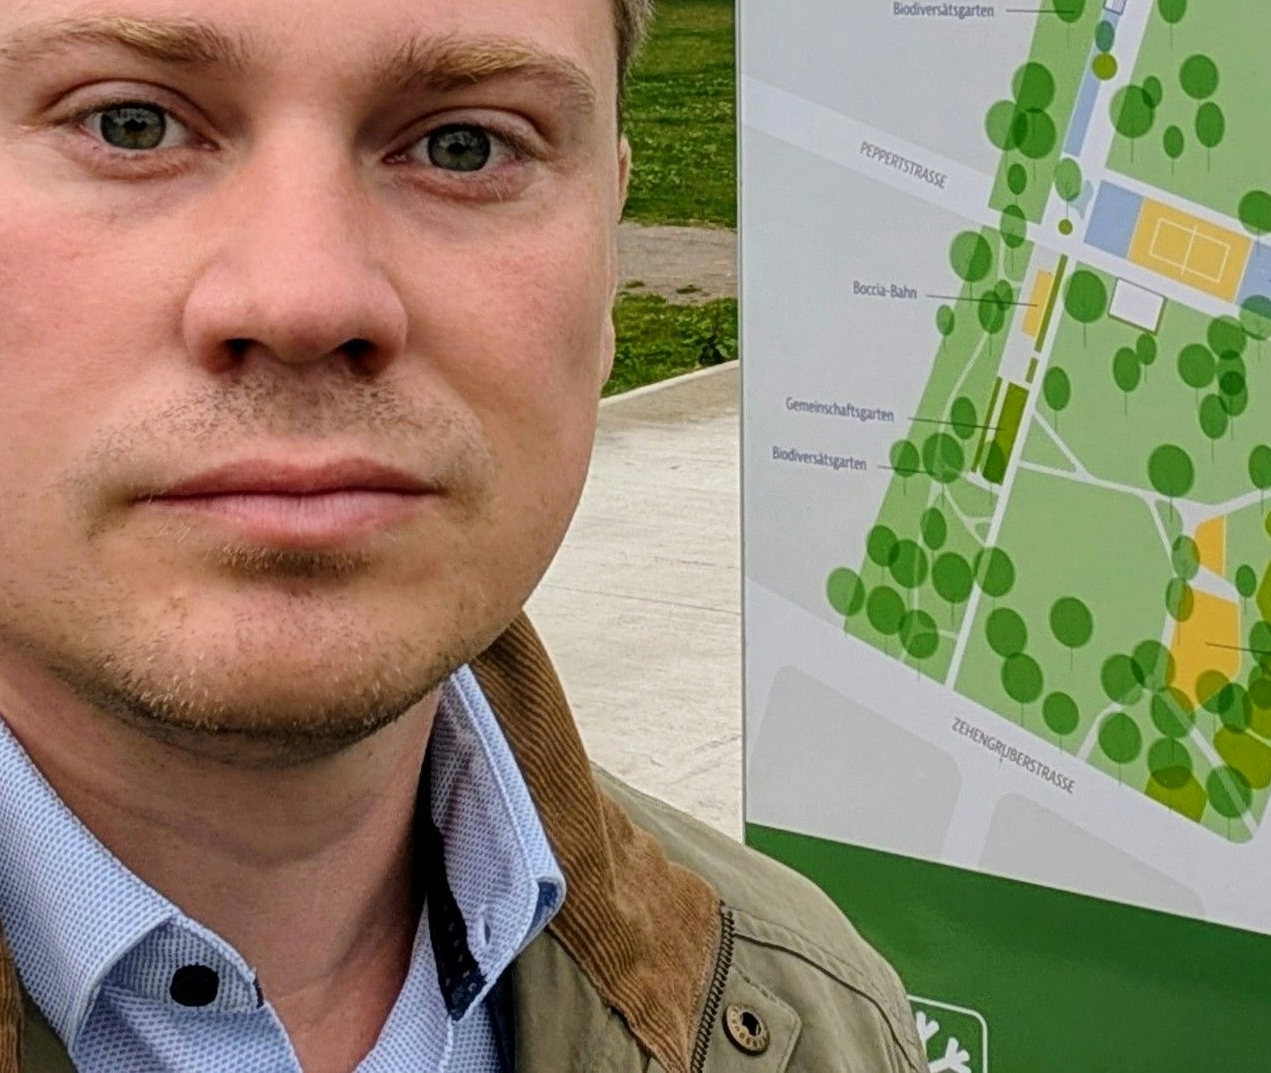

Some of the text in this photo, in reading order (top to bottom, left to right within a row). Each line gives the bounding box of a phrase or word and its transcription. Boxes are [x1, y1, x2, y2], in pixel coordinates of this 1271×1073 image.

[859, 140, 947, 190] PEPPERTSTRASSE
[853, 280, 918, 301] Boccia-Bahn
[785, 396, 895, 423] Gemeinschaftsgarten
[951, 716, 1076, 795] ZEHENGRUBERSTRASSE
